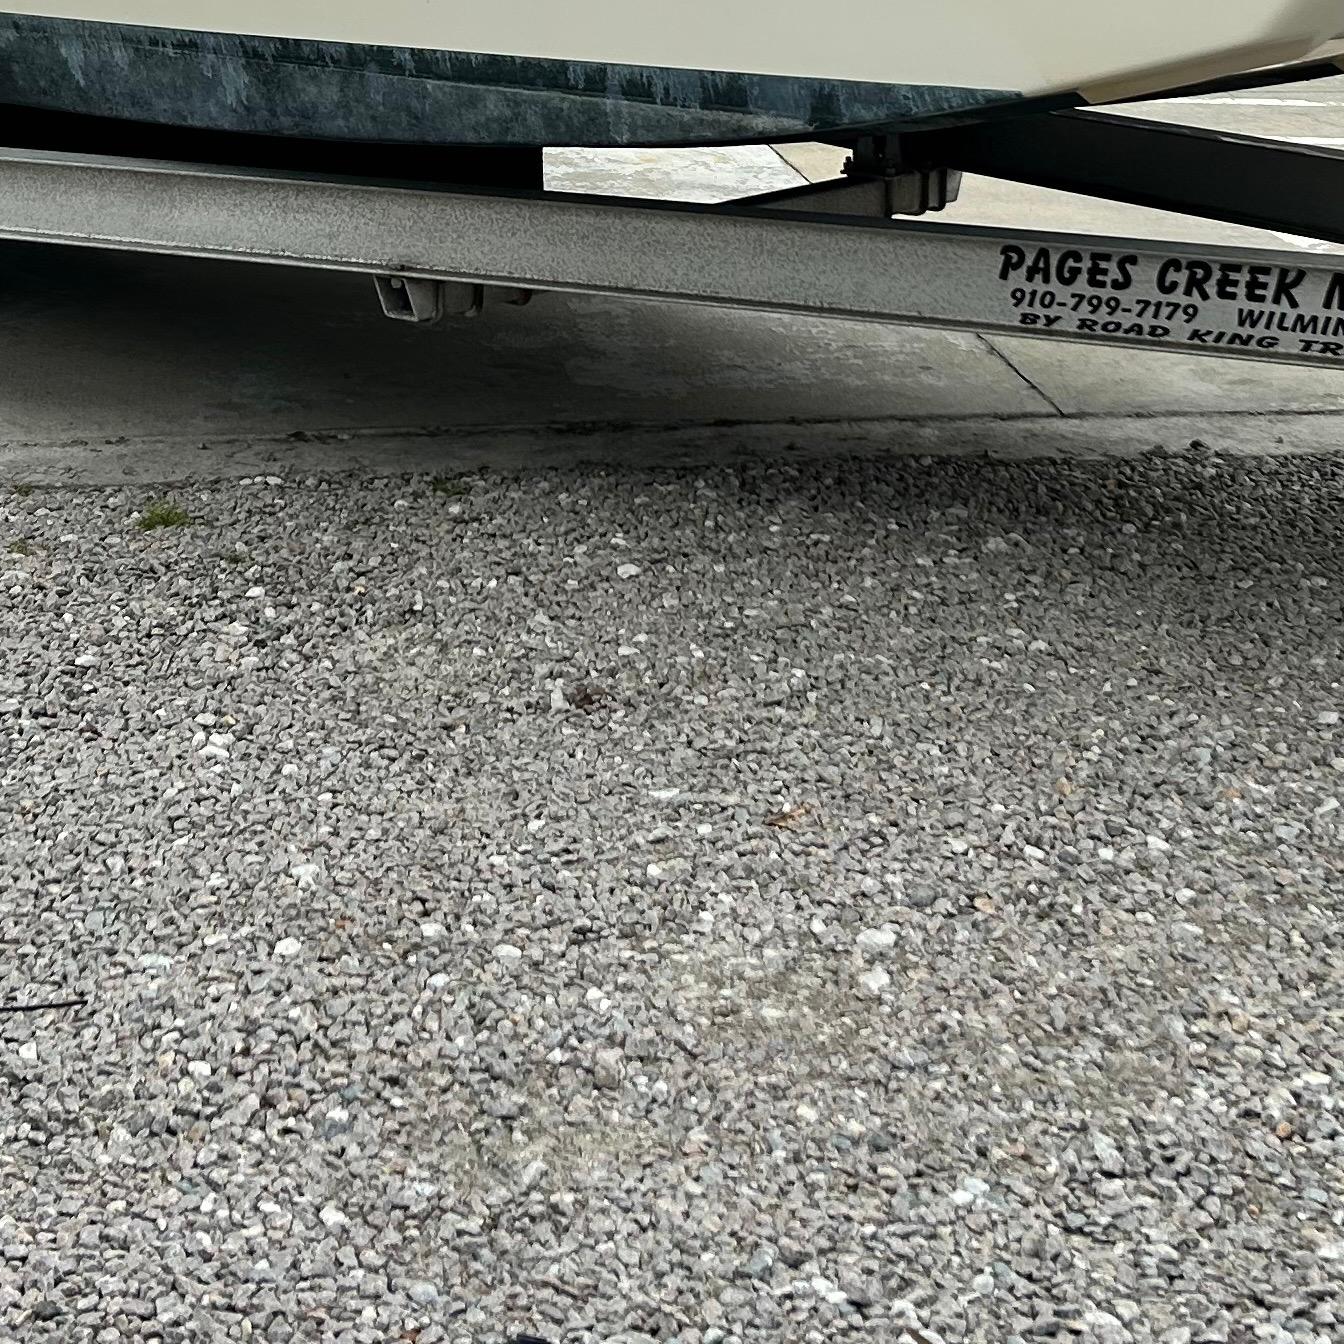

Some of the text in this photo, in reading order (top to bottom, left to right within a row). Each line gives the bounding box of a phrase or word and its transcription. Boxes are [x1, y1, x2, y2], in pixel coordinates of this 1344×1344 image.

[998, 243, 1138, 291] PAGES
[1156, 257, 1307, 310] CREEK
[1009, 287, 1199, 325] 910-799-7179
[1018, 311, 1062, 327] BY
[1075, 317, 1171, 339] ROAD
[1186, 328, 1281, 349] KING
